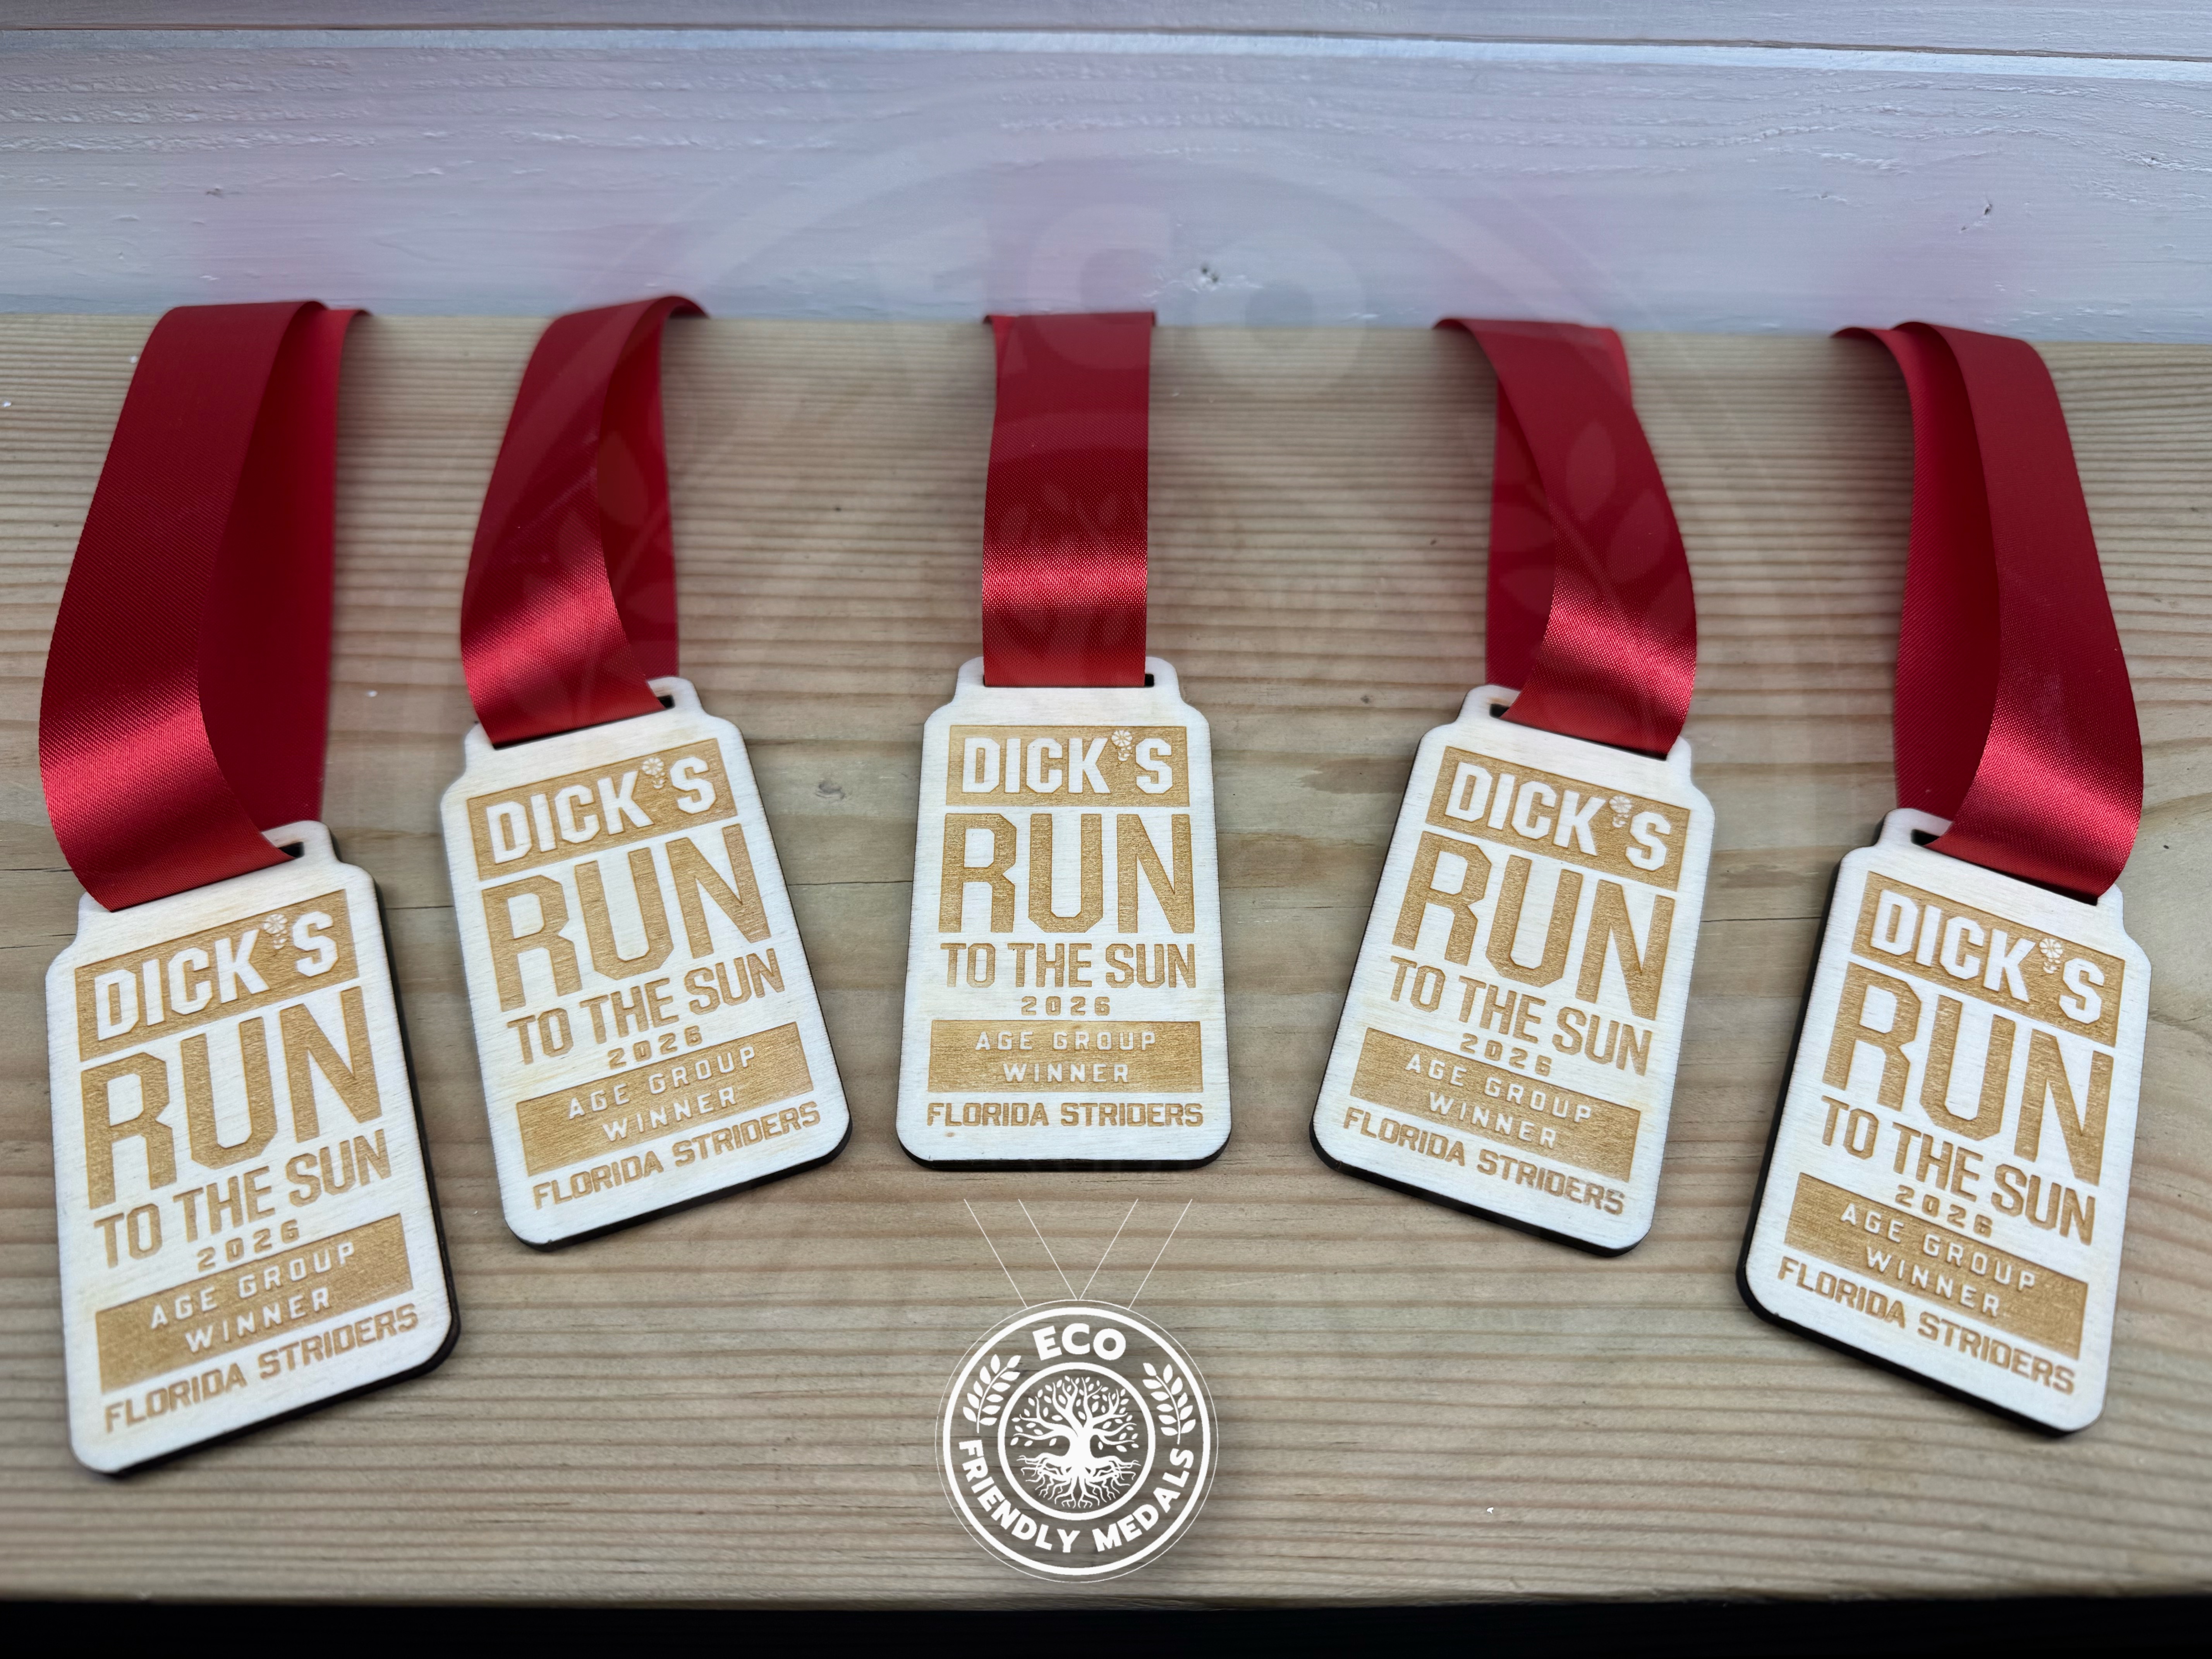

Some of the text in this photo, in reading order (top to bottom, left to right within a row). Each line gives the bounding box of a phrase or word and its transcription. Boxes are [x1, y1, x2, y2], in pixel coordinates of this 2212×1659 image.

[962, 729, 1173, 794] DICK'S
[486, 756, 717, 864] DICK'S
[1444, 761, 1671, 871] DICK'S
[482, 823, 772, 1011] RUN
[938, 813, 1195, 934] RUN
[940, 943, 1196, 988] TO THE SUN
[1392, 830, 1675, 1021] RUN
[1870, 889, 2104, 1025] DICK'S
[95, 910, 338, 1041] DICK'S
[507, 948, 785, 1065] TO THE SUN
[1021, 996, 1111, 1016] 2026
[1390, 955, 1652, 1076] TO THE SUN
[568, 1046, 756, 1118] AGE GROUP
[608, 1026, 703, 1068] 2026
[975, 1031, 1156, 1051] AGE GROUP
[1002, 1063, 1128, 1083] WINNER
[1460, 1033, 1552, 1077] 2026
[1822, 960, 2114, 1187] RUN
[81, 986, 381, 1209] RUN
[602, 1085, 736, 1142] WINNER
[927, 1103, 1204, 1126] FLORIDA STRIDERS
[1405, 1054, 1592, 1122] AGE GROUP
[1429, 1092, 1557, 1148] WINNER
[93, 1129, 391, 1268] TO THE SUN
[533, 1103, 821, 1209] FLORIDA STRIDERS
[1343, 1107, 1626, 1215] FLORIDA STRIDERS
[1821, 1096, 2095, 1246] TO THE SUN
[198, 1219, 301, 1270] 2026
[1839, 1204, 2035, 1290] AGE GROUP
[1895, 1185, 1992, 1238] 2026
[151, 1242, 355, 1329] AGE GROUP
[184, 1286, 330, 1353] WINNER
[1865, 1247, 2000, 1316] WINNER
[105, 1304, 419, 1433] FLORIDA STRIDERS
[1778, 1257, 2074, 1394] FLORIDA STRIDERS
